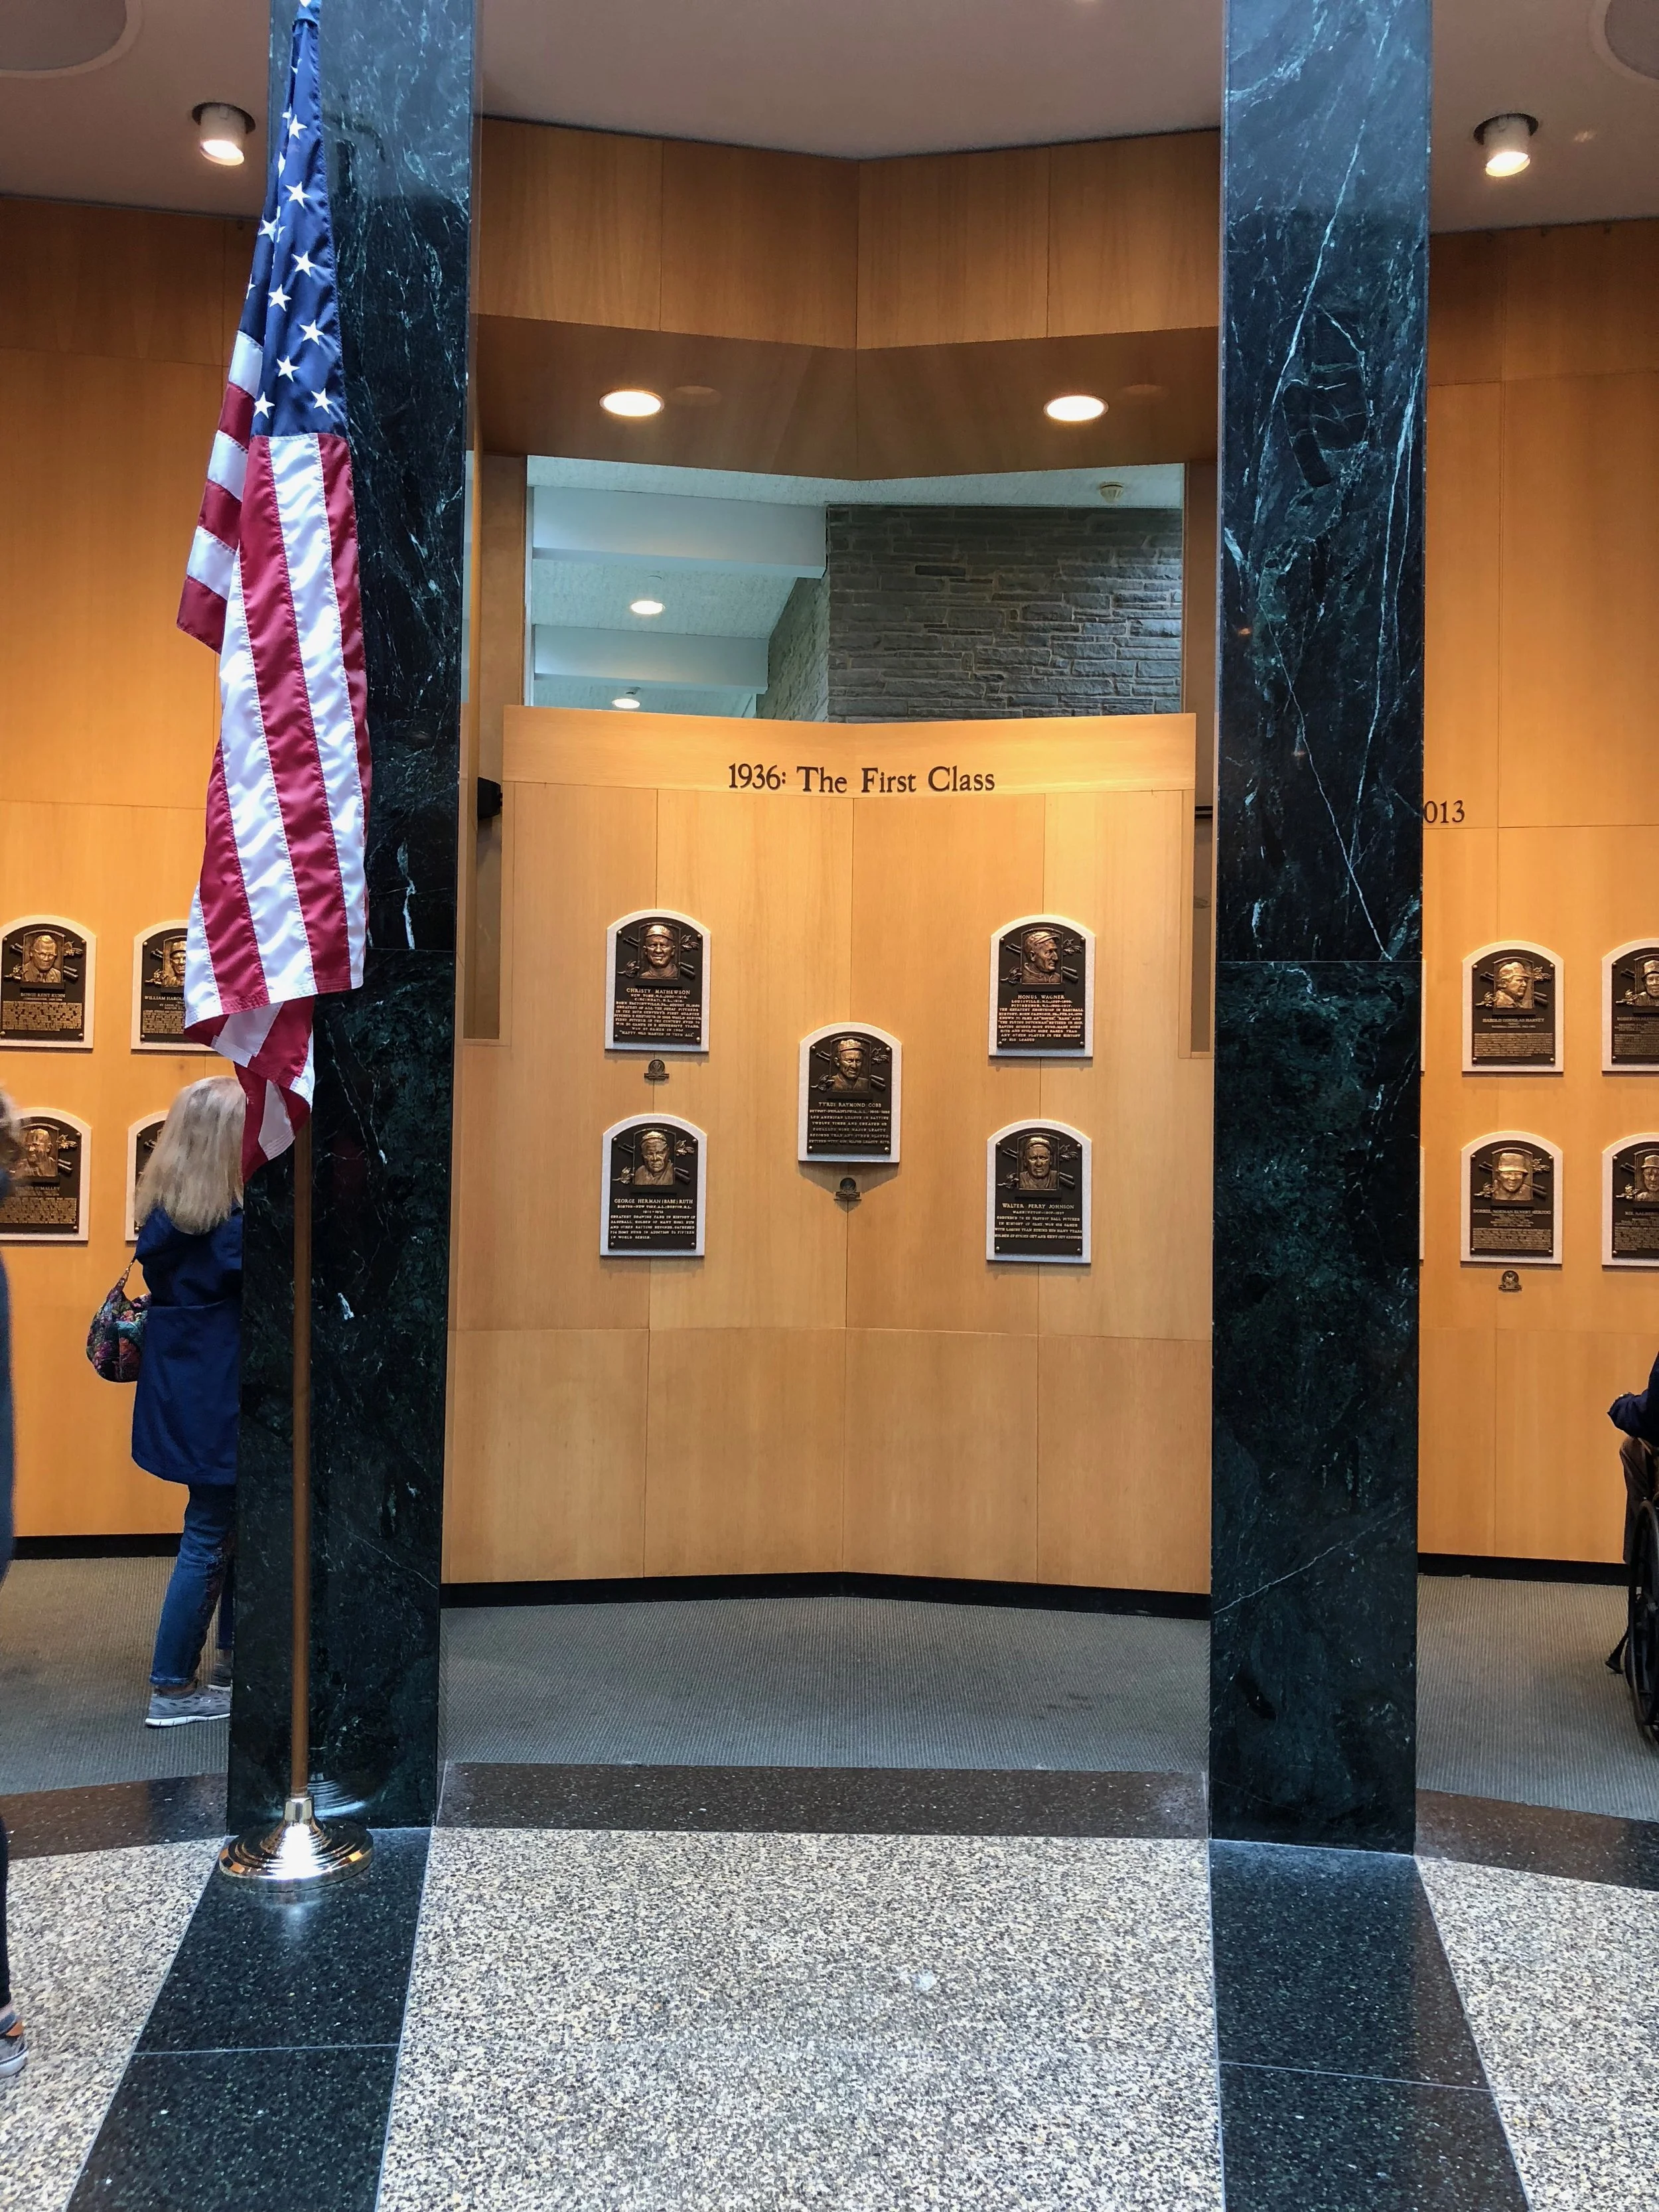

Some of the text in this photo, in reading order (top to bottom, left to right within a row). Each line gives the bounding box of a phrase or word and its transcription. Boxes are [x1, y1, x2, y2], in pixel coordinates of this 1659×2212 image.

[728, 763, 995, 793] 1936: The First Class
